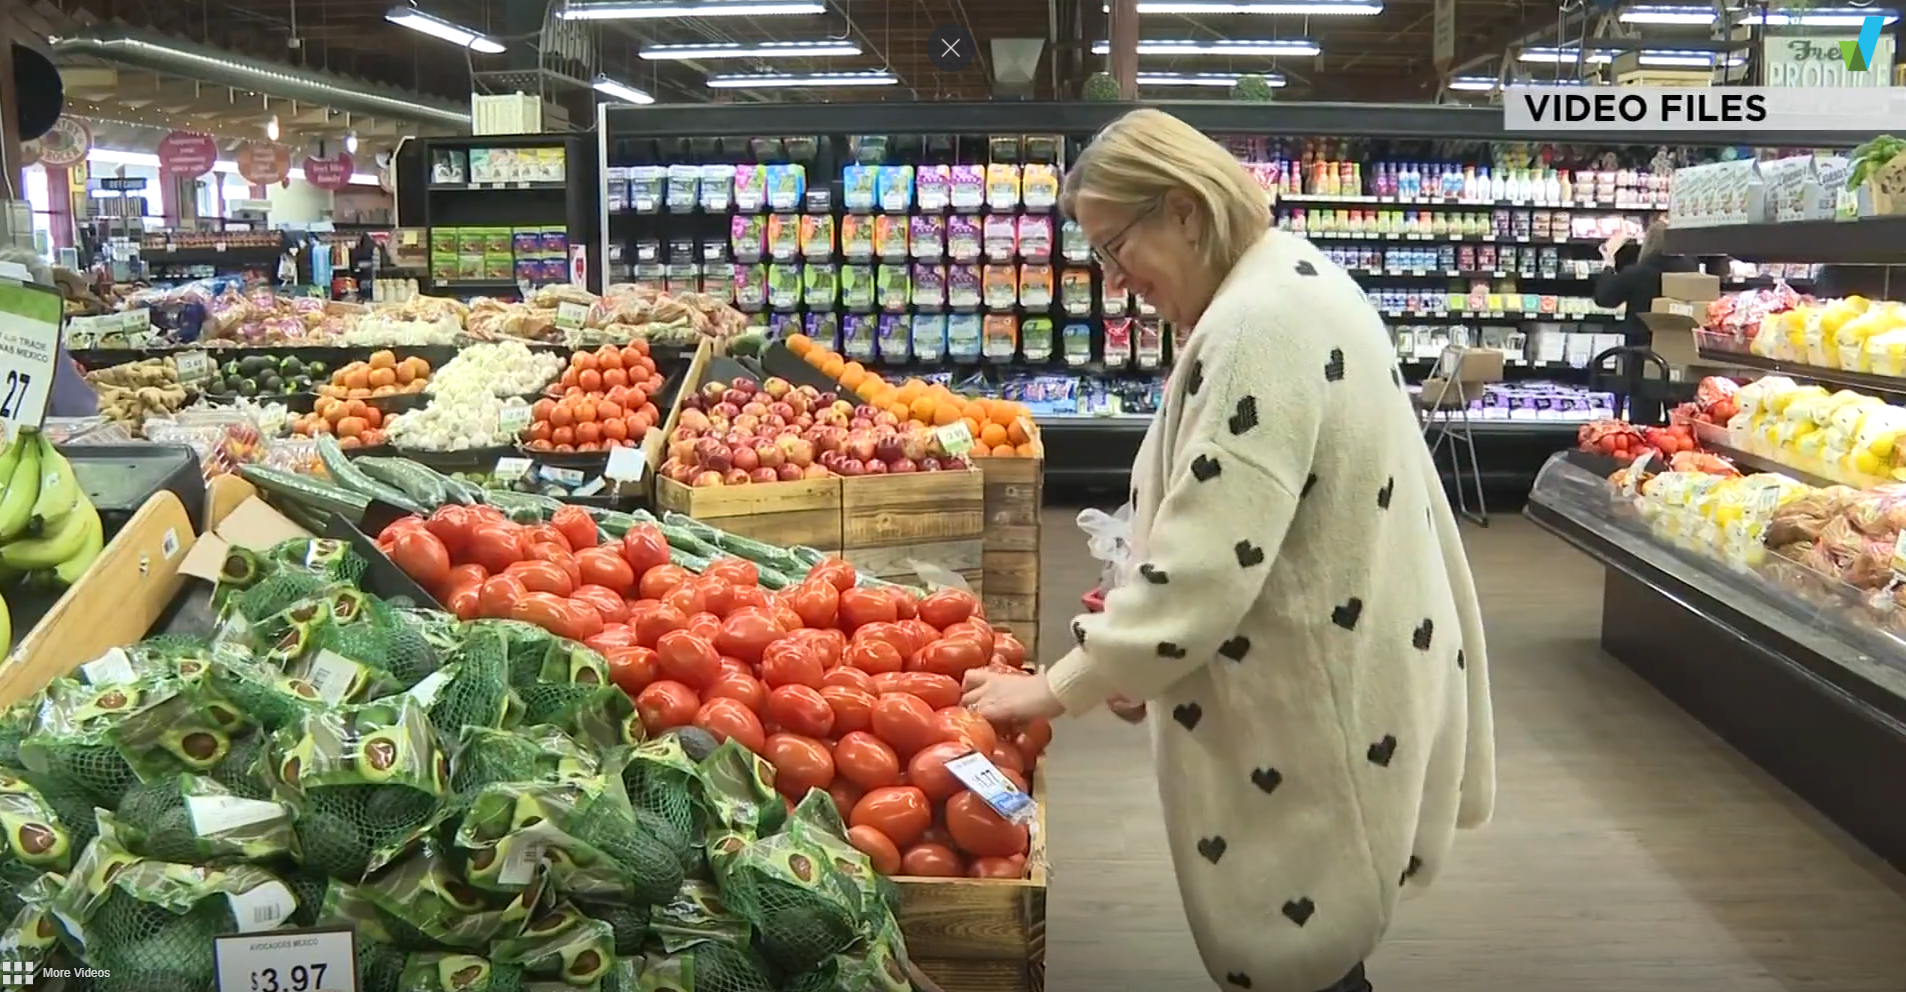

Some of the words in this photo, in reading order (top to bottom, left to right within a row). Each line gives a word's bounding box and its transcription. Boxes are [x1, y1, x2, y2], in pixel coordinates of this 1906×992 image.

[1788, 39, 1845, 61] Fre
[20, 337, 47, 351] TRADE
[17, 349, 48, 363] MEXICO
[293, 938, 319, 948] MEXICO
